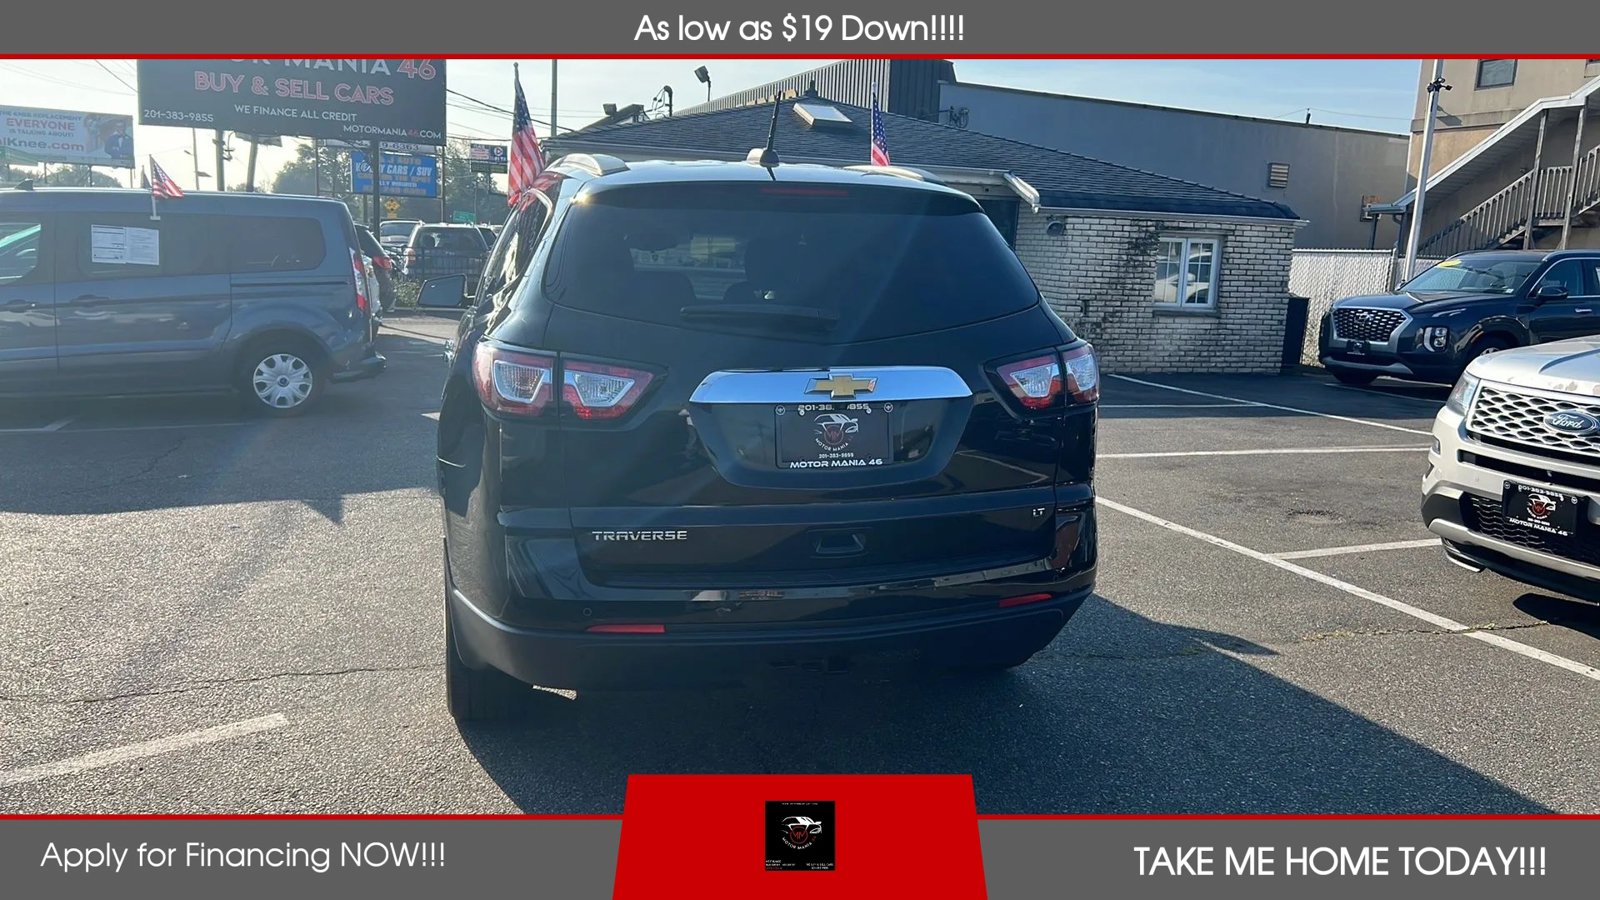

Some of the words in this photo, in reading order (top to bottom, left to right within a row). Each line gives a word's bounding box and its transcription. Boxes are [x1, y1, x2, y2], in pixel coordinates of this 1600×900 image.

[397, 59, 436, 80] 46
[194, 70, 245, 93] BUY
[251, 76, 269, 96] &
[275, 78, 330, 101] SELL
[334, 83, 394, 106] CARS
[144, 109, 214, 123] 201-383-9855
[234, 104, 251, 114] WE
[253, 105, 298, 118] FINANCE
[300, 110, 319, 120] ALL
[321, 111, 357, 122] CREDIT
[7, 117, 75, 131] EVERYONE
[387, 165, 408, 175] CARS
[416, 166, 433, 176] SUV
[1552, 413, 1585, 429] Ford
[790, 460, 829, 469] MOTOR
[831, 459, 866, 467] MANIA
[869, 458, 883, 466] 46
[1033, 507, 1045, 517] LT
[592, 530, 688, 541] TRAVERSE
